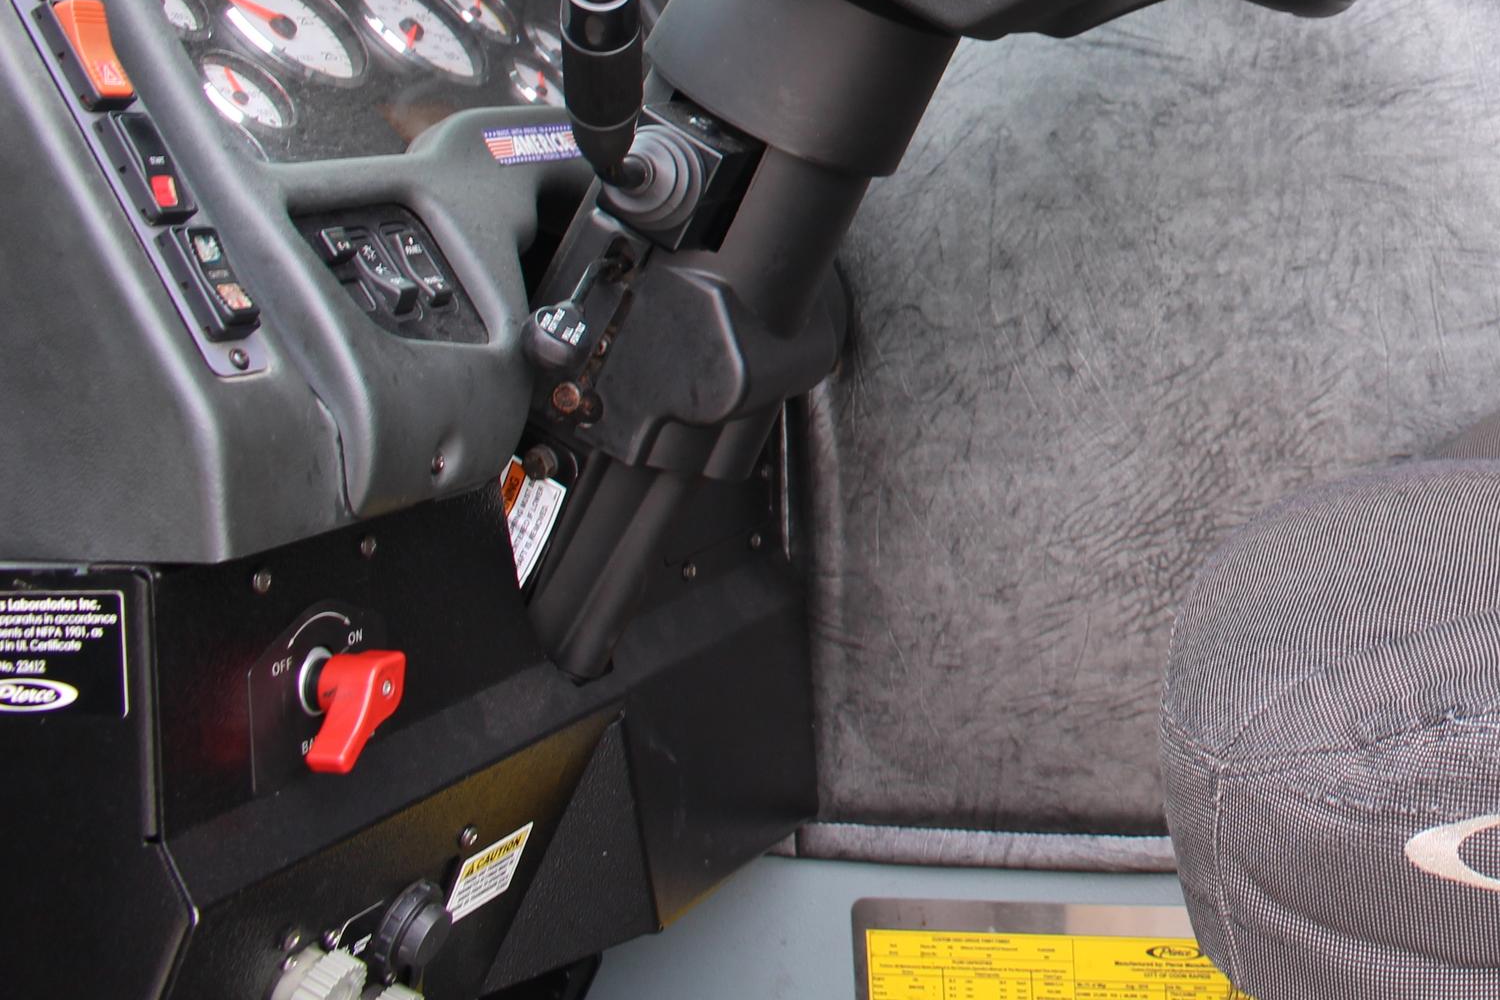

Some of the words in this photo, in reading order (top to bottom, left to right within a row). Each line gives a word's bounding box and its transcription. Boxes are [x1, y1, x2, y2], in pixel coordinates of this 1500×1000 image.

[513, 132, 576, 156] AMERICA
[8, 597, 77, 612] Laboratories
[79, 597, 101, 611] Inc.
[44, 612, 54, 625] in
[55, 612, 118, 625] accordance
[24, 626, 35, 638] of
[36, 626, 62, 638] NFPA
[91, 627, 104, 638] as
[347, 628, 363, 646] ON
[30, 639, 82, 652] Certificate
[16, 660, 46, 674] 23412
[272, 656, 293, 676] OFF
[0, 684, 57, 703] Pierce
[476, 835, 523, 869] CAUTION
